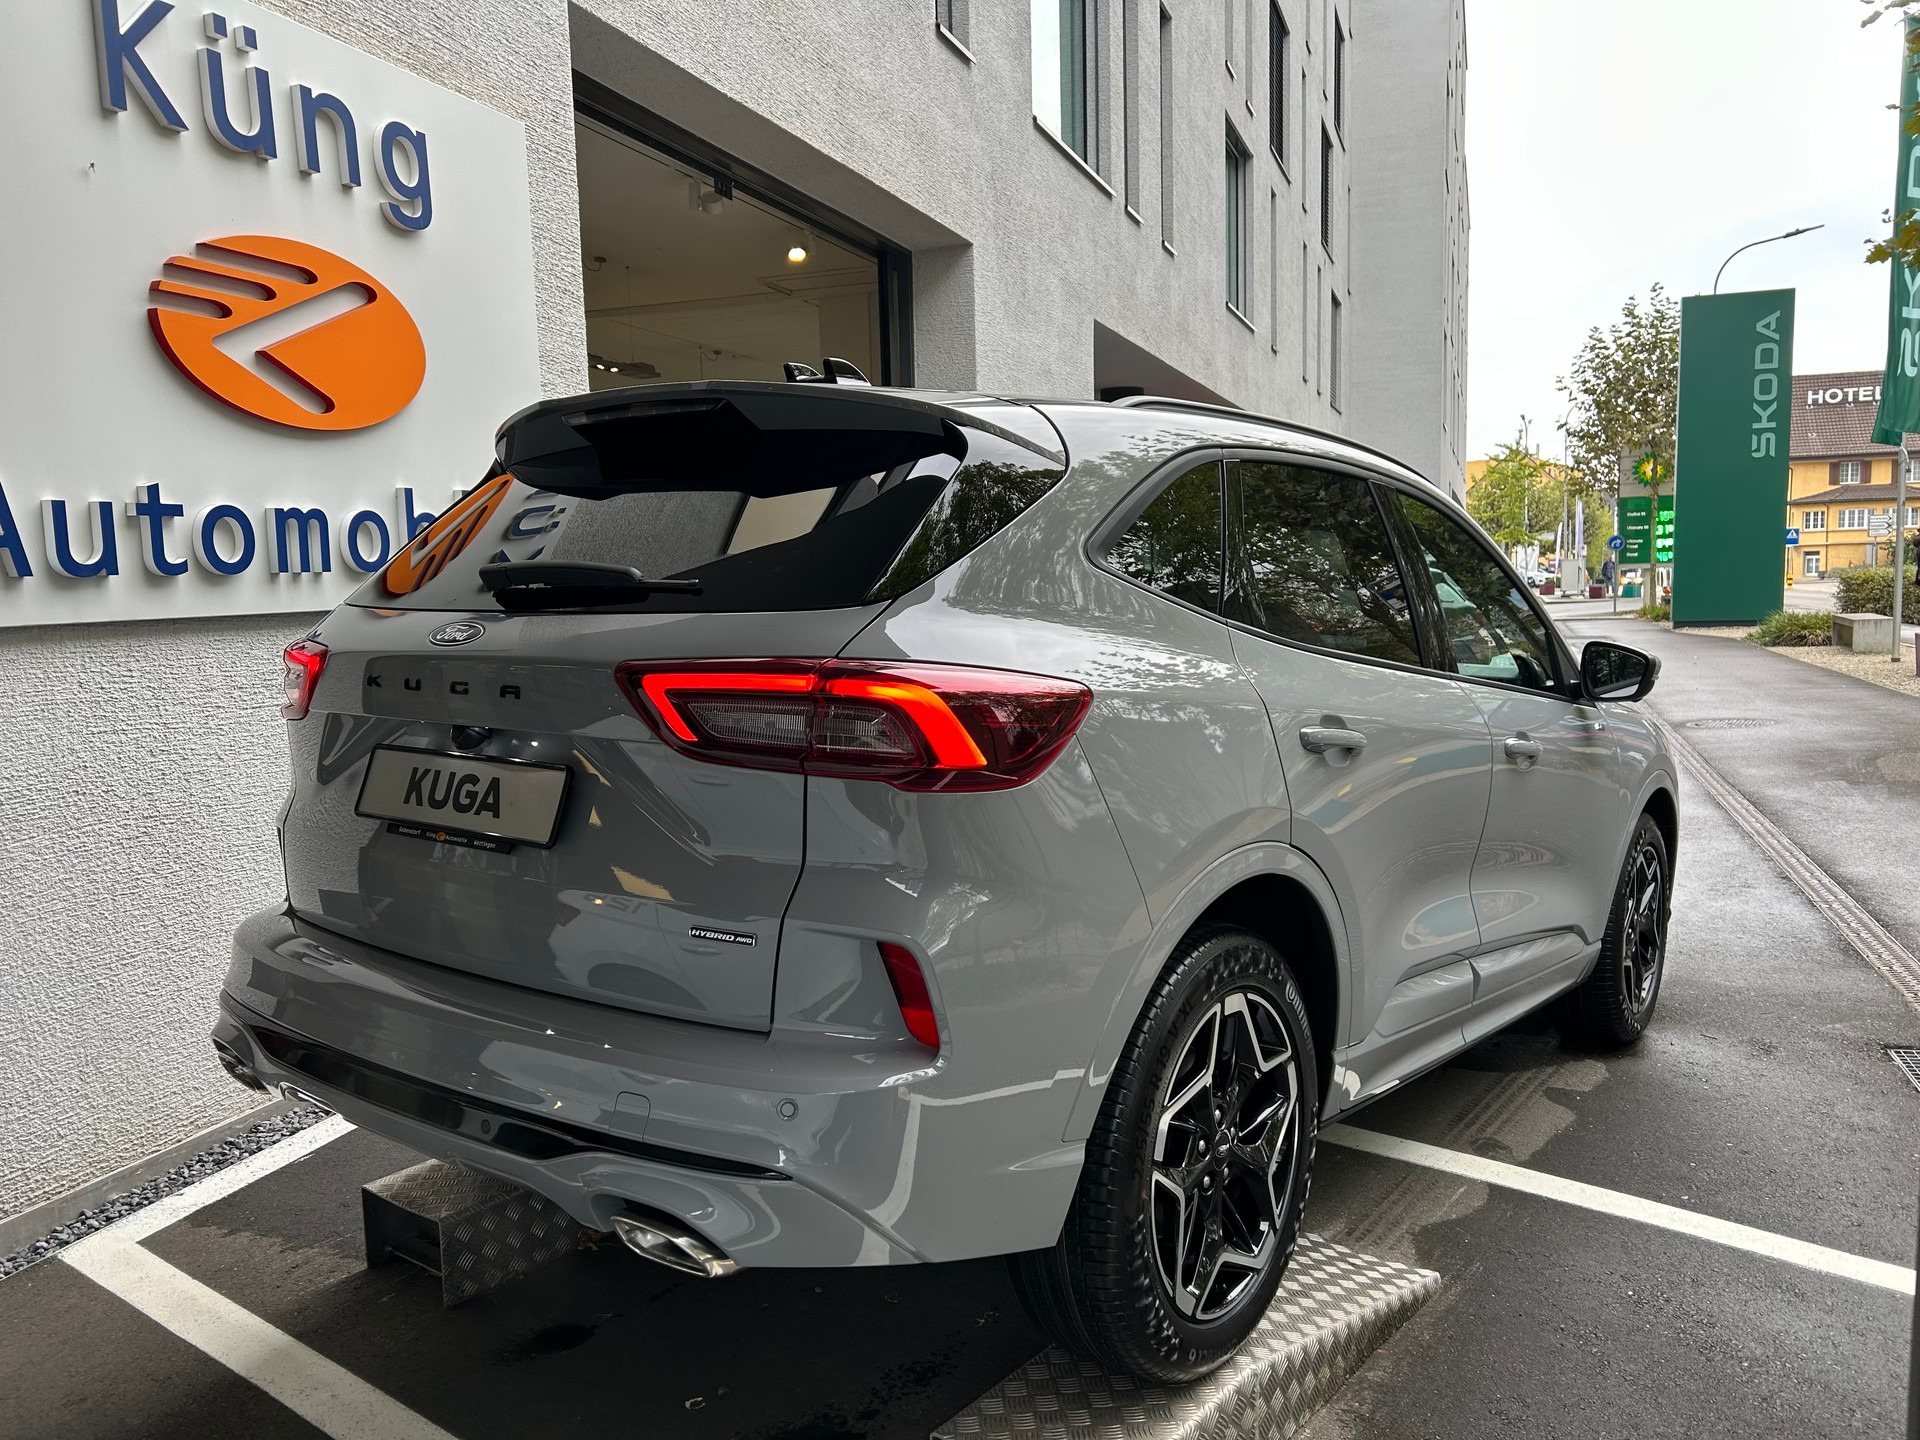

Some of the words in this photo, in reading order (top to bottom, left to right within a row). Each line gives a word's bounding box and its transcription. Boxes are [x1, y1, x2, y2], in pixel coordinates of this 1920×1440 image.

[92, 0, 433, 232] Küng
[0, 480, 468, 578] Automob
[366, 673, 522, 700] KUGA
[402, 766, 502, 819] KUGA
[691, 929, 735, 941] HYBRID
[736, 936, 753, 944] AWD
